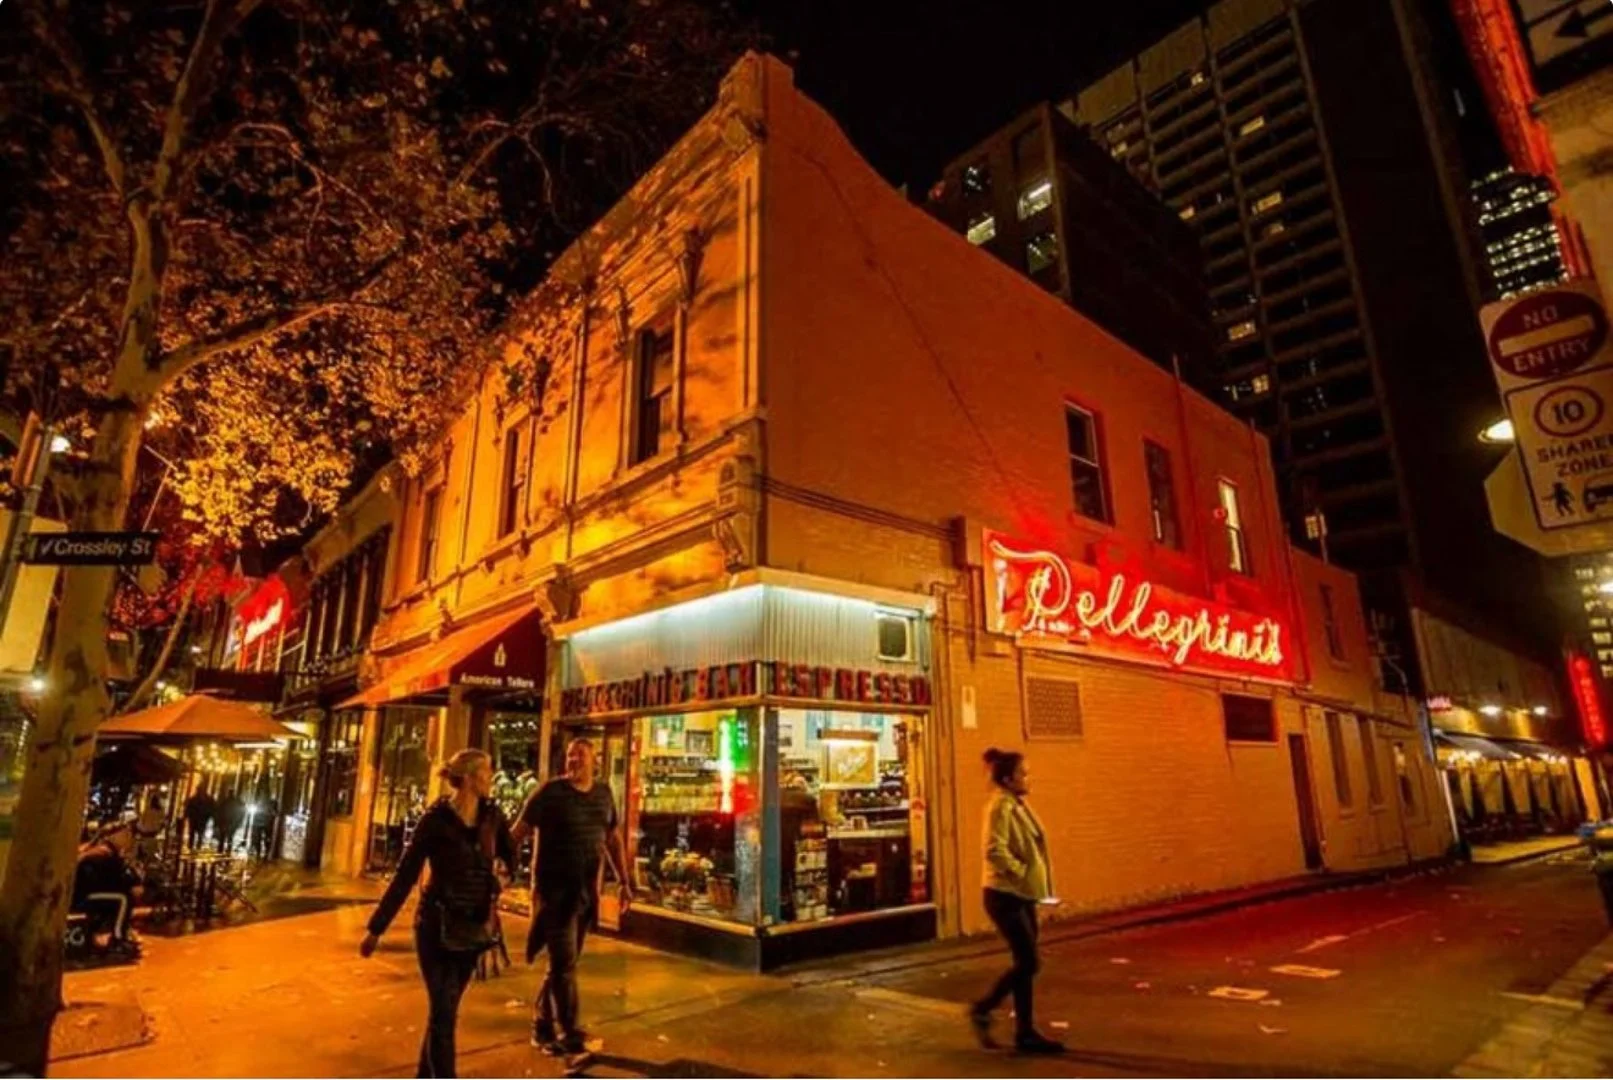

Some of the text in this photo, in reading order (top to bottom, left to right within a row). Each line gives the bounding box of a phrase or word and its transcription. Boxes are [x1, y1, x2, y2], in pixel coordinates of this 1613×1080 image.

[1523, 305, 1558, 330] NO
[1513, 337, 1590, 372] ENTRY
[1553, 398, 1585, 425] 10
[1556, 452, 1611, 478] ZONE
[54, 538, 152, 557] Crossley St
[690, 661, 757, 703] BAR
[775, 661, 932, 705] ESPRESSO
